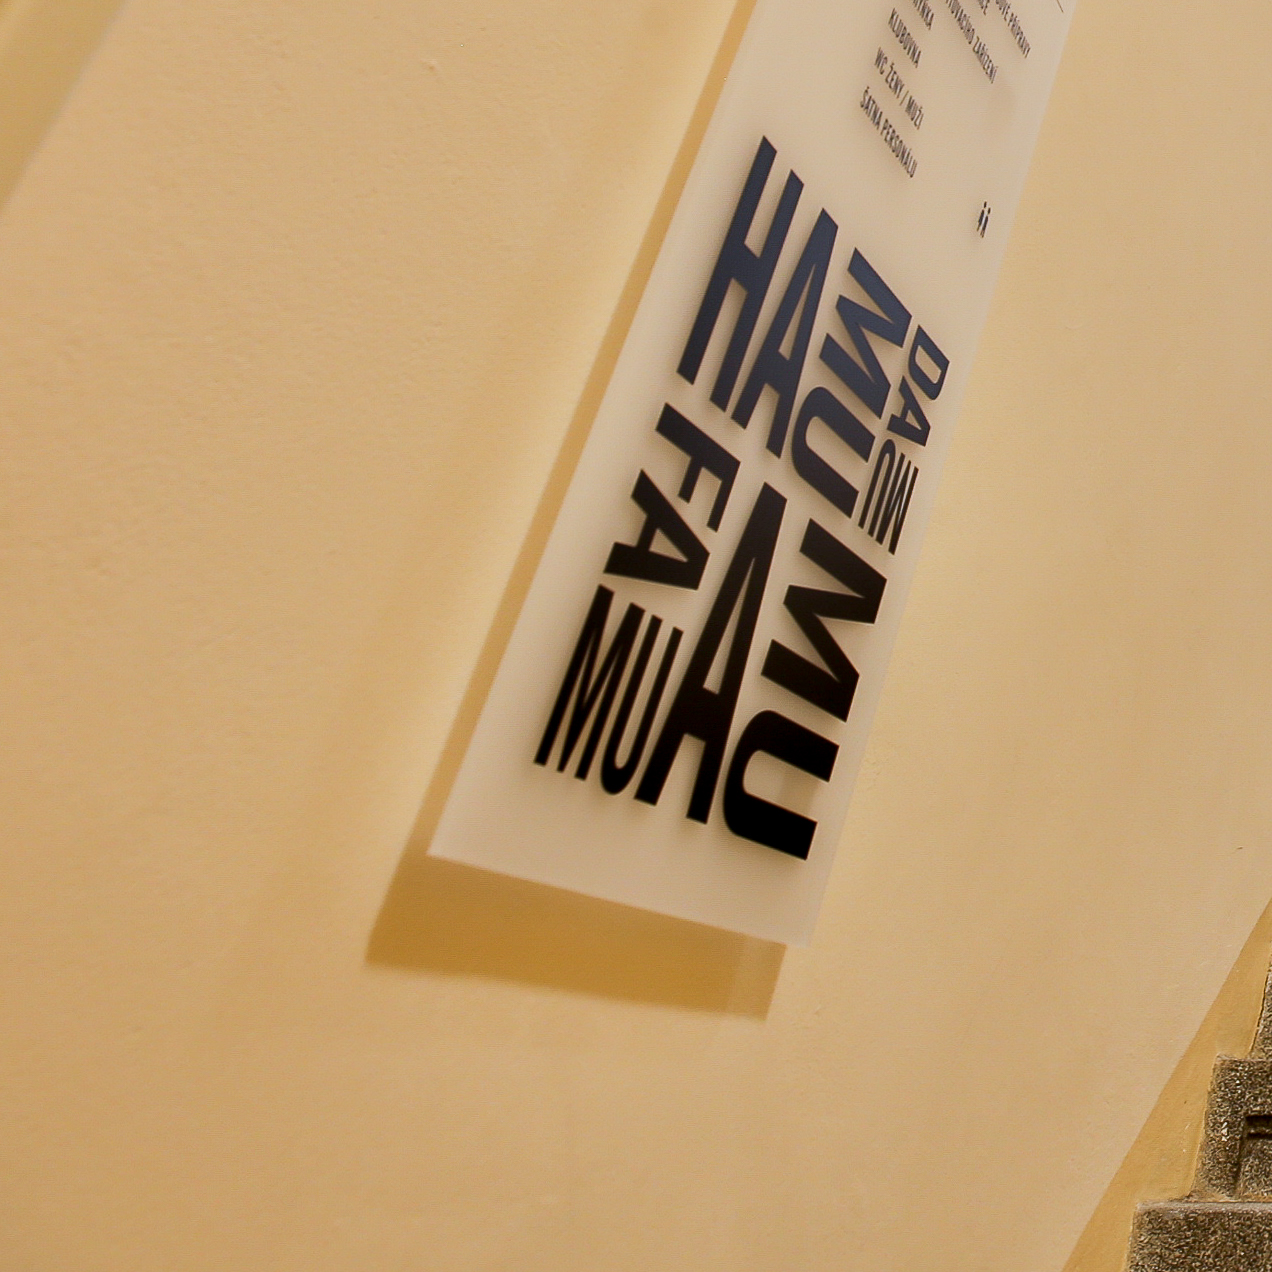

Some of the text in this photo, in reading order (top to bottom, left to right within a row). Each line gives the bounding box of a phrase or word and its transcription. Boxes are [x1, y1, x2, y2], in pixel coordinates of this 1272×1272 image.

[888, 10, 921, 68] KLUBOVNA
[972, 34, 998, 84] ZAŘÍZENÍ
[1007, 11, 1031, 60] PŘÍPRAVY
[874, 49, 888, 75] WC
[885, 63, 904, 99] ŽENY
[905, 94, 924, 130] MUŽI
[859, 86, 918, 179] ŠATNA PERSONÁLU
